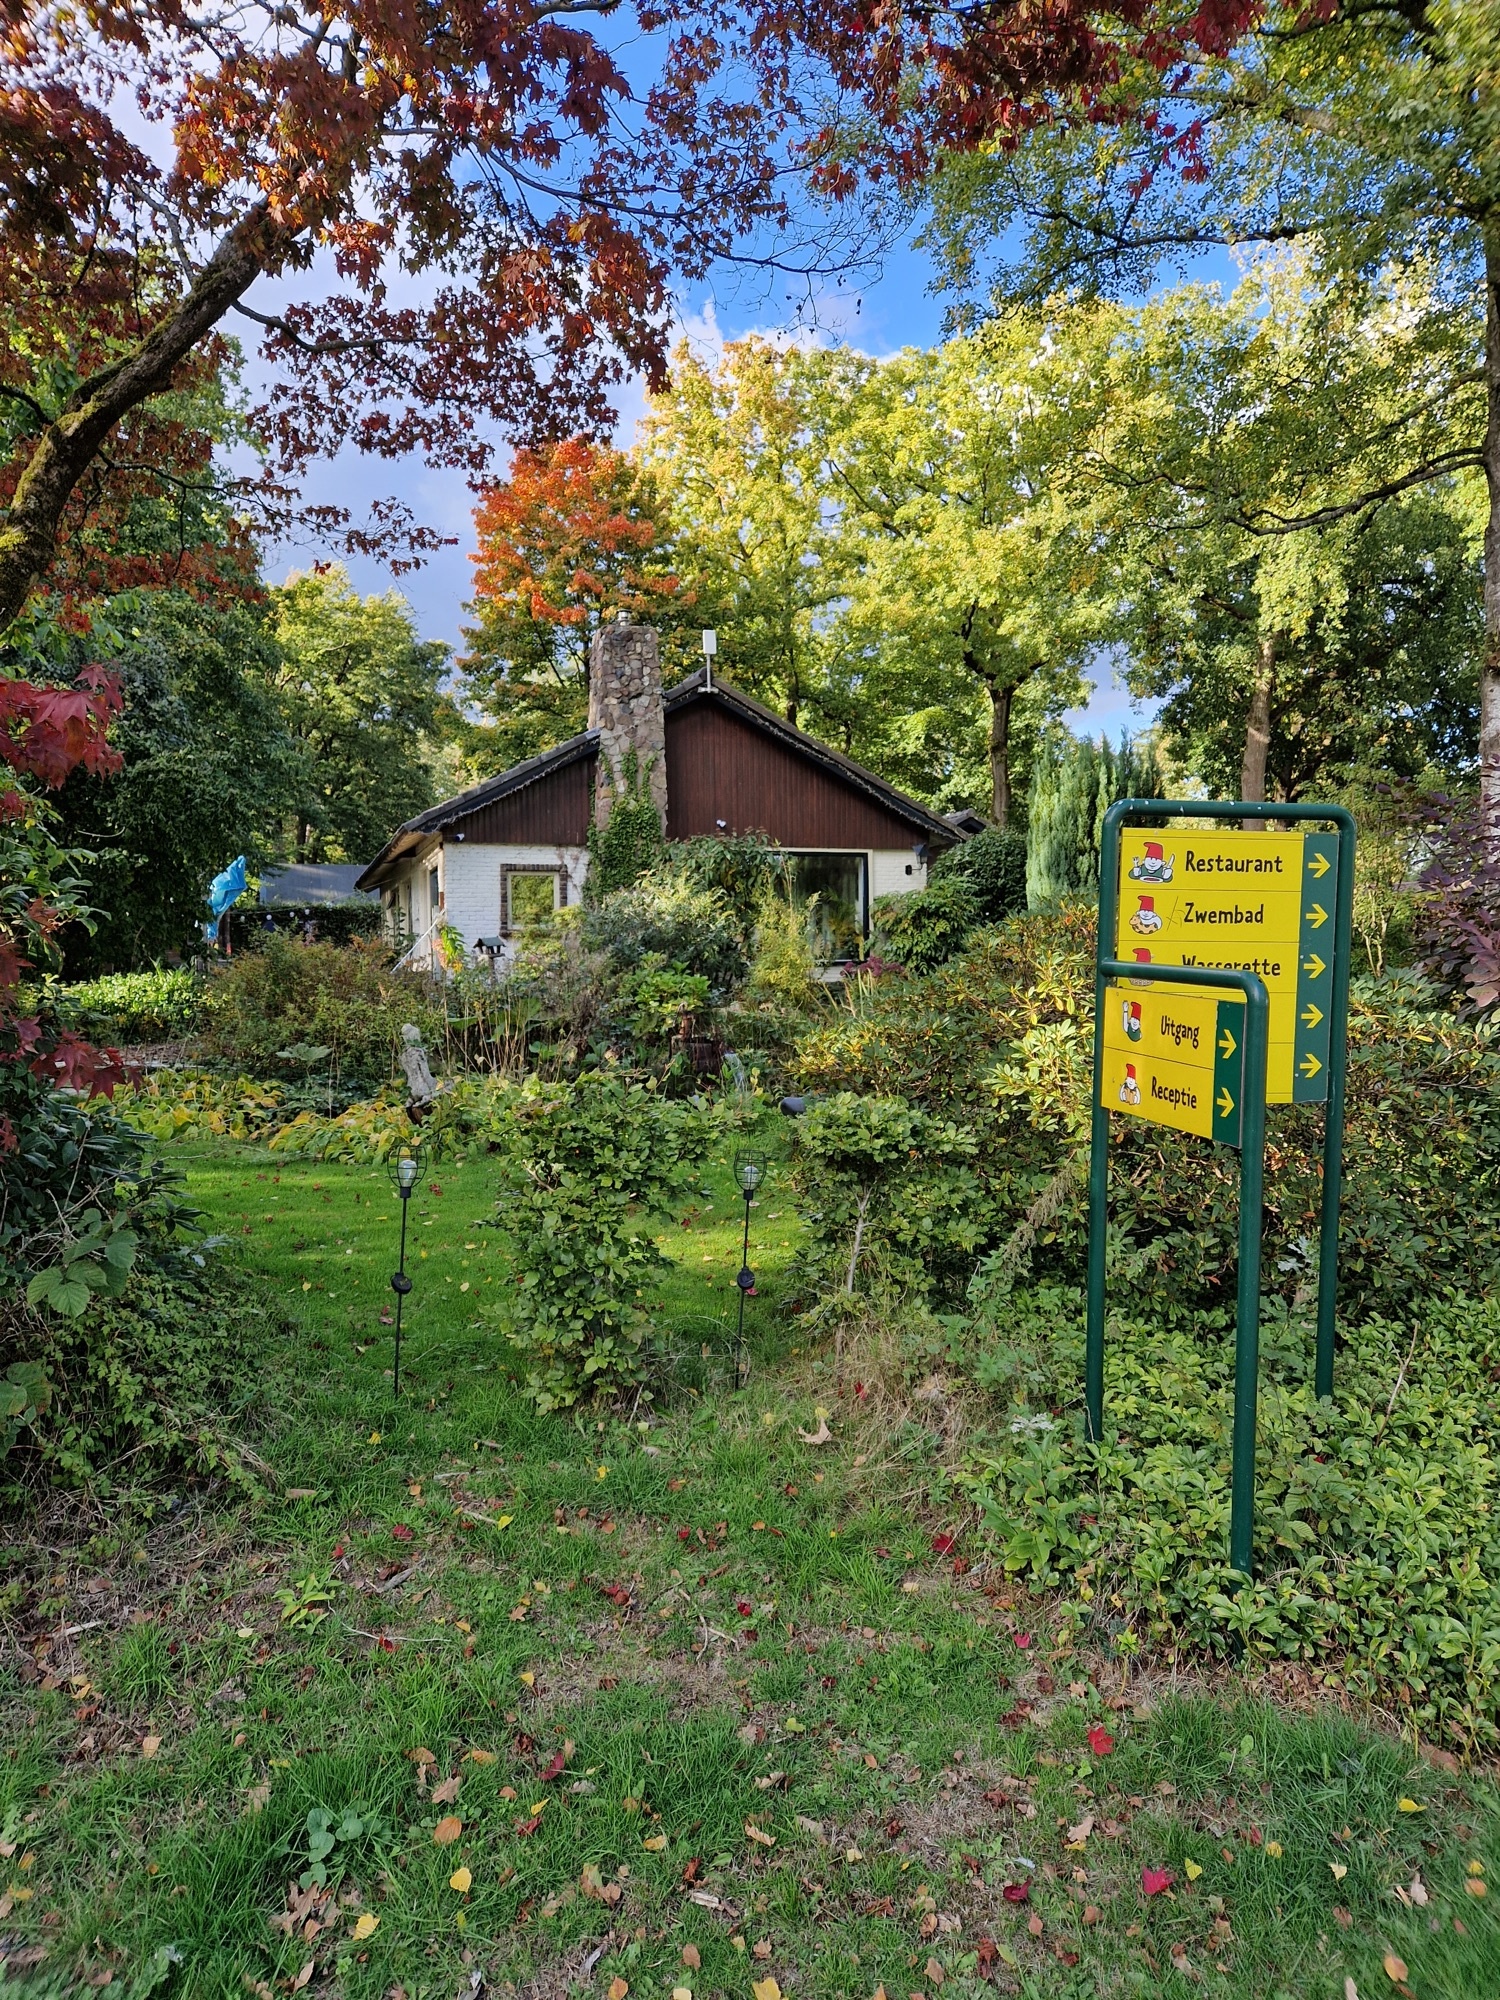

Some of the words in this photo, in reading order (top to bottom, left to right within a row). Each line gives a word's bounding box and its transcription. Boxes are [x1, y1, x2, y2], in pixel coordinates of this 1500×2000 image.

[1185, 850, 1283, 873] Restaurant
[1184, 902, 1264, 924] Zwembad
[1161, 1015, 1200, 1050] Uitgang
[1151, 1075, 1197, 1111] Receptie
